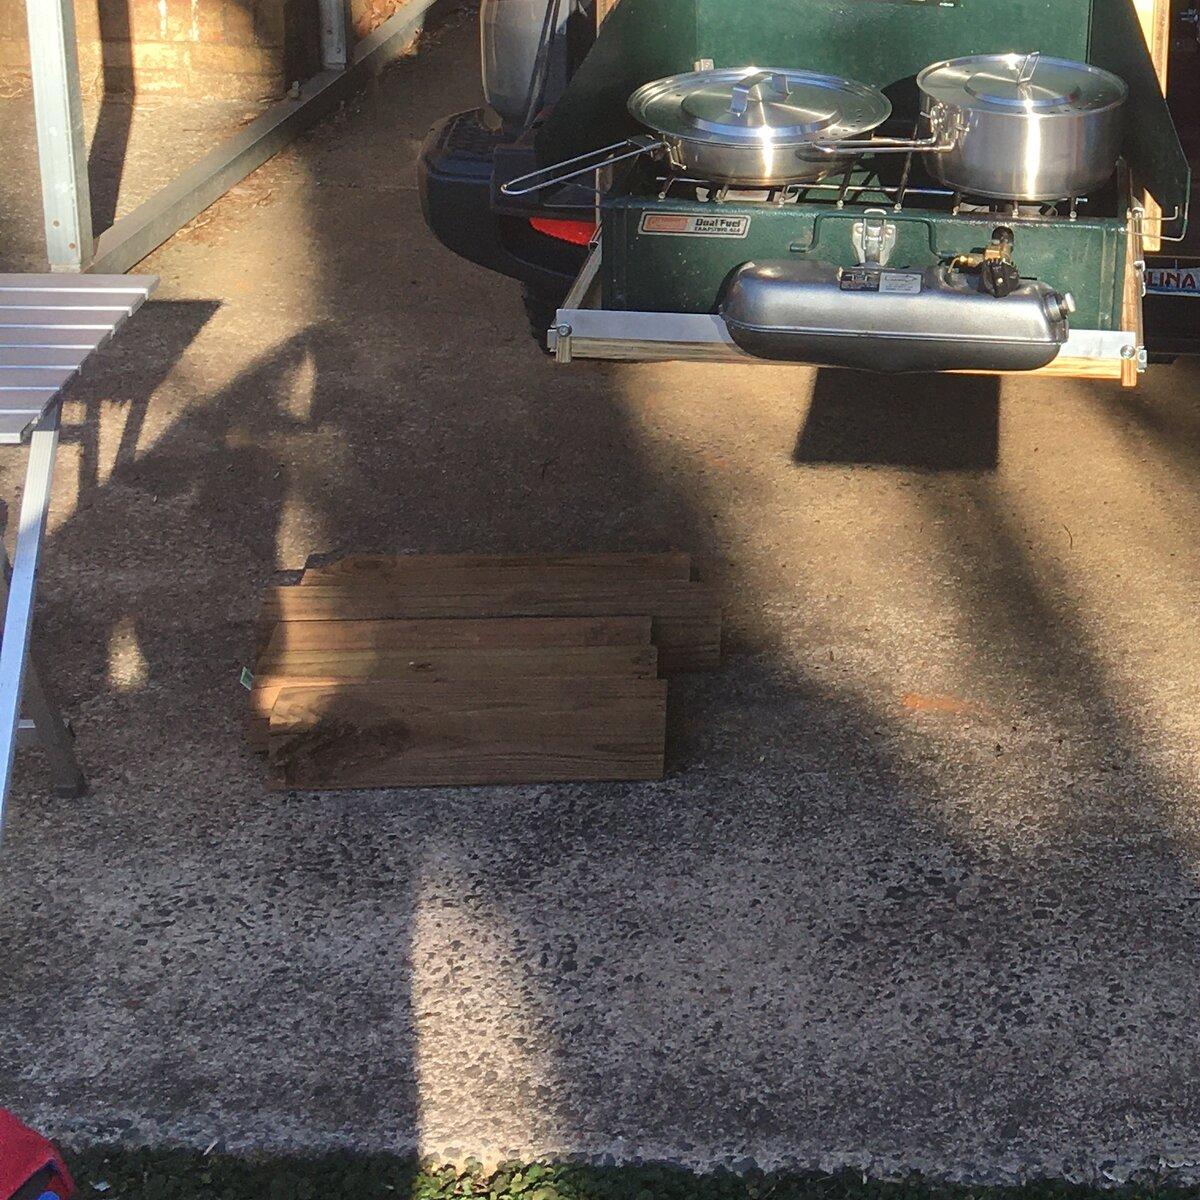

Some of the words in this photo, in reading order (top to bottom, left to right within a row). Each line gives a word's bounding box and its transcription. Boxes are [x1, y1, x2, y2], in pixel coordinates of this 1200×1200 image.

[695, 218, 718, 226] Dual
[720, 219, 741, 227] Fuel
[1143, 271, 1196, 289] LINA
